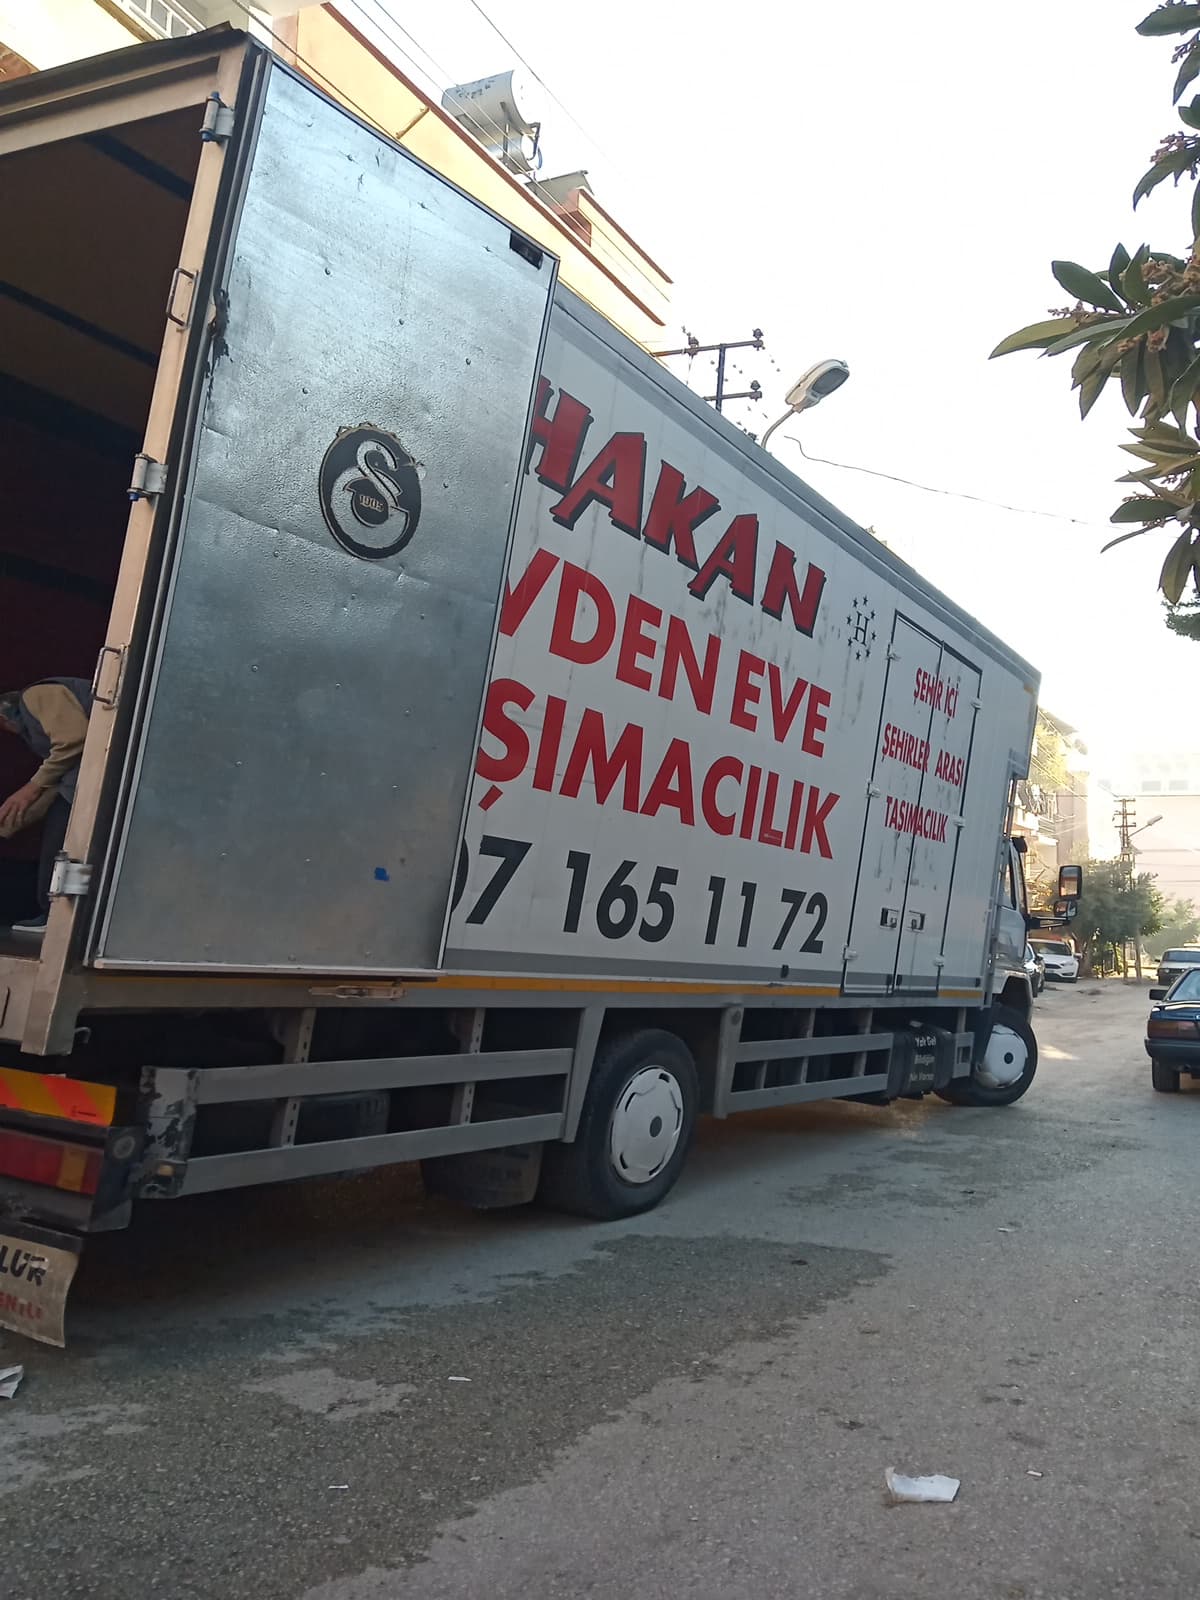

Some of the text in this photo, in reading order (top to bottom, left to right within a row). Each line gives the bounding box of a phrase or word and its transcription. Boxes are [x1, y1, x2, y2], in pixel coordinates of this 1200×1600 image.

[525, 375, 826, 638] HAKAN
[499, 548, 832, 759] VDEN EVE
[474, 678, 840, 860] ŞIMACILIK
[881, 722, 965, 788] ŞEHİRLER ARASI
[452, 834, 828, 954] 7 165 11 72
